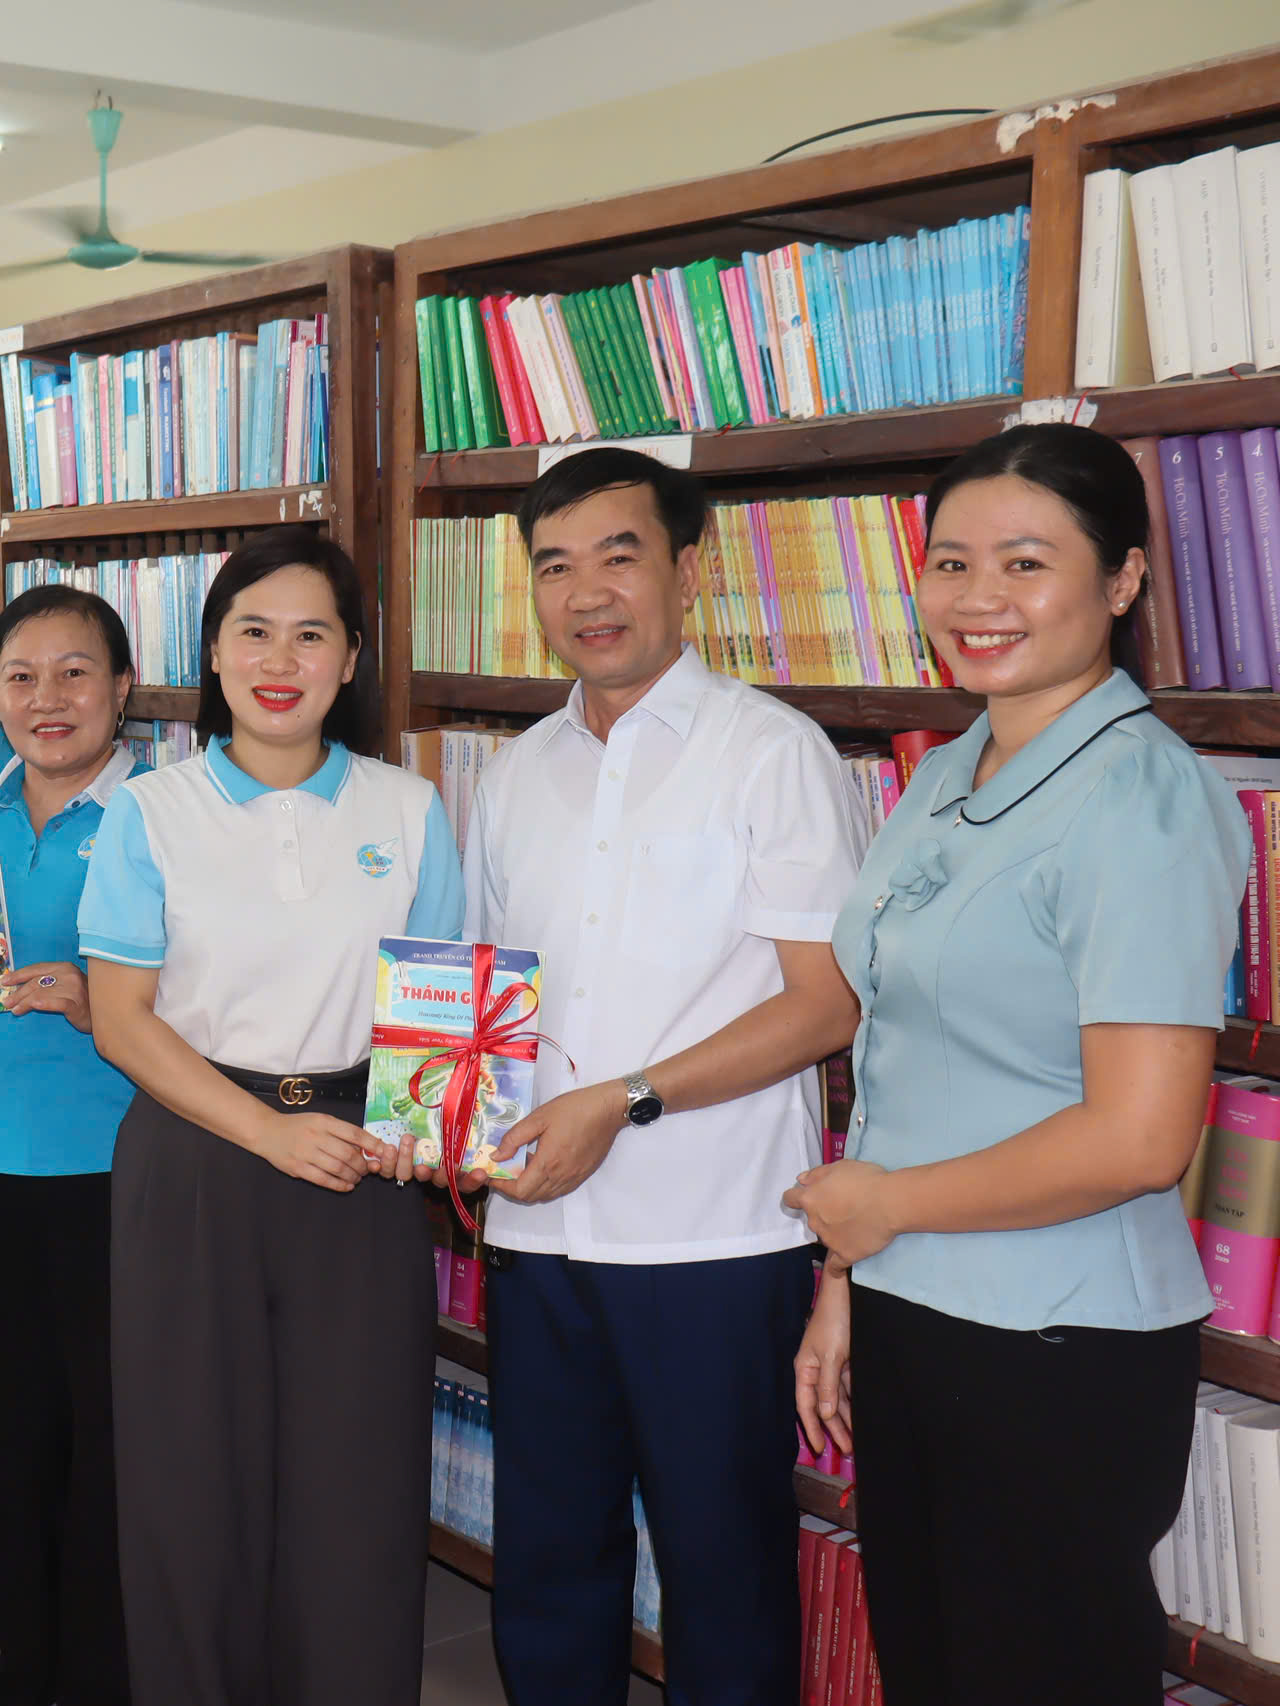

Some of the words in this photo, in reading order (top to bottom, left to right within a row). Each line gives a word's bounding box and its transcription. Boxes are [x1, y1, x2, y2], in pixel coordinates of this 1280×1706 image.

[1172, 451, 1182, 464] 6
[1215, 446, 1224, 461] 5
[1251, 442, 1263, 457] 4
[1178, 511, 1189, 538] Minh
[1220, 506, 1232, 534] Minh
[1257, 504, 1270, 534] Minh
[400, 984, 457, 1004] THÁNH
[1216, 1243, 1230, 1255] 68
